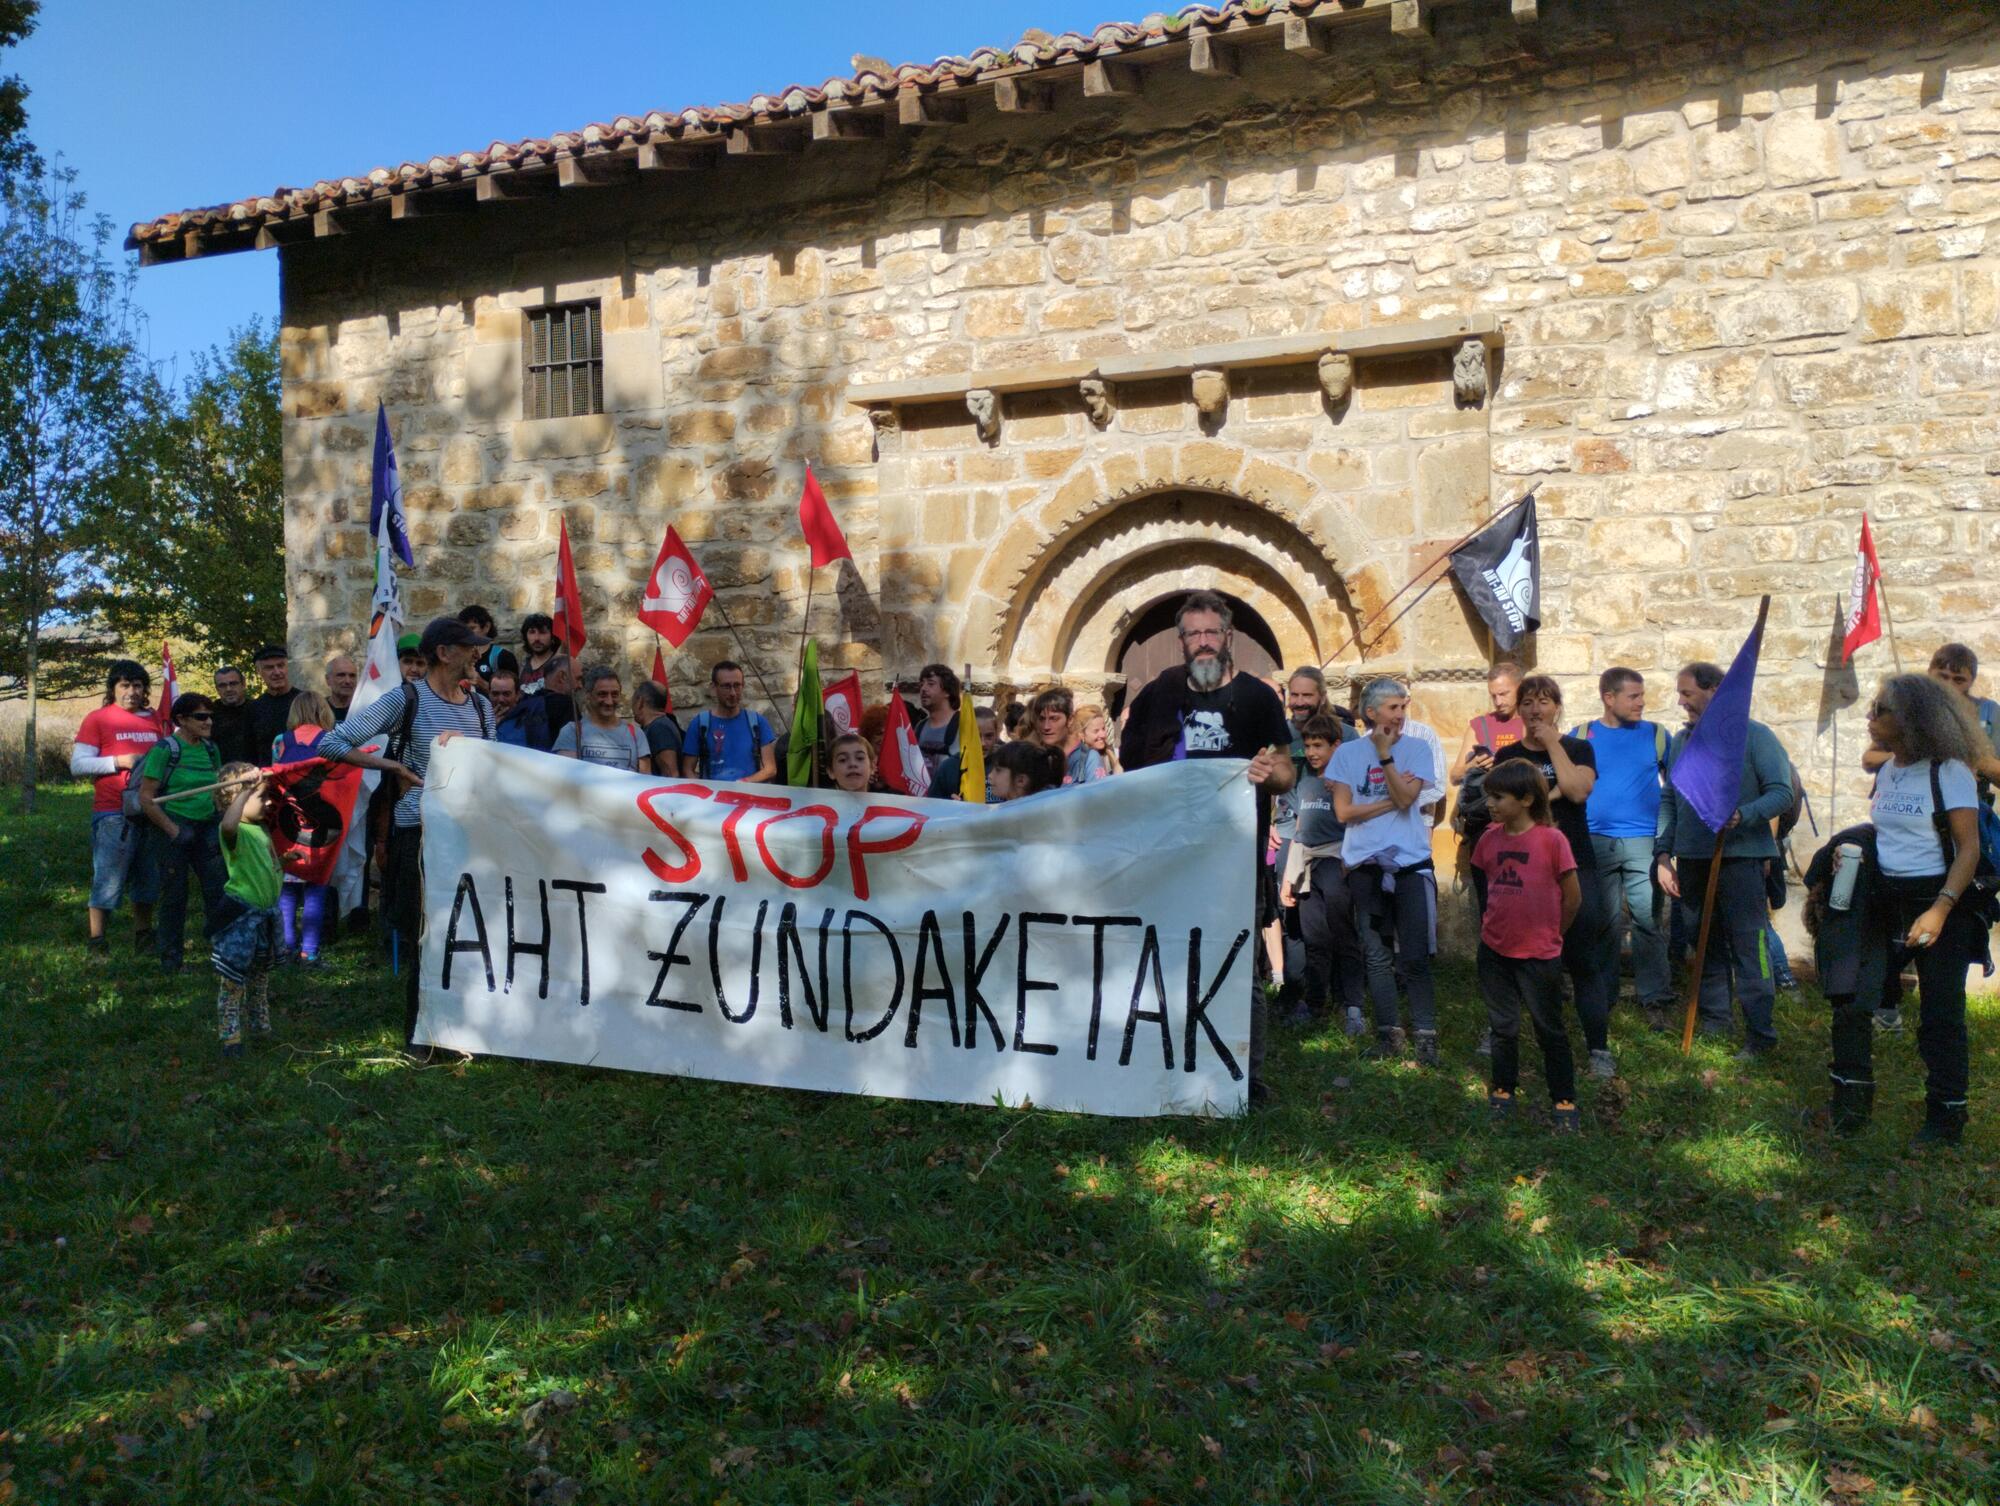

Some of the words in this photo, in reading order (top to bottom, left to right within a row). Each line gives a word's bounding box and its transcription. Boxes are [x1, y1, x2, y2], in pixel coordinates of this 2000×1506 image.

[637, 782, 930, 901] STOP
[441, 872, 607, 1006] AHT
[645, 889, 1251, 1082] ZUNDAKETAK
